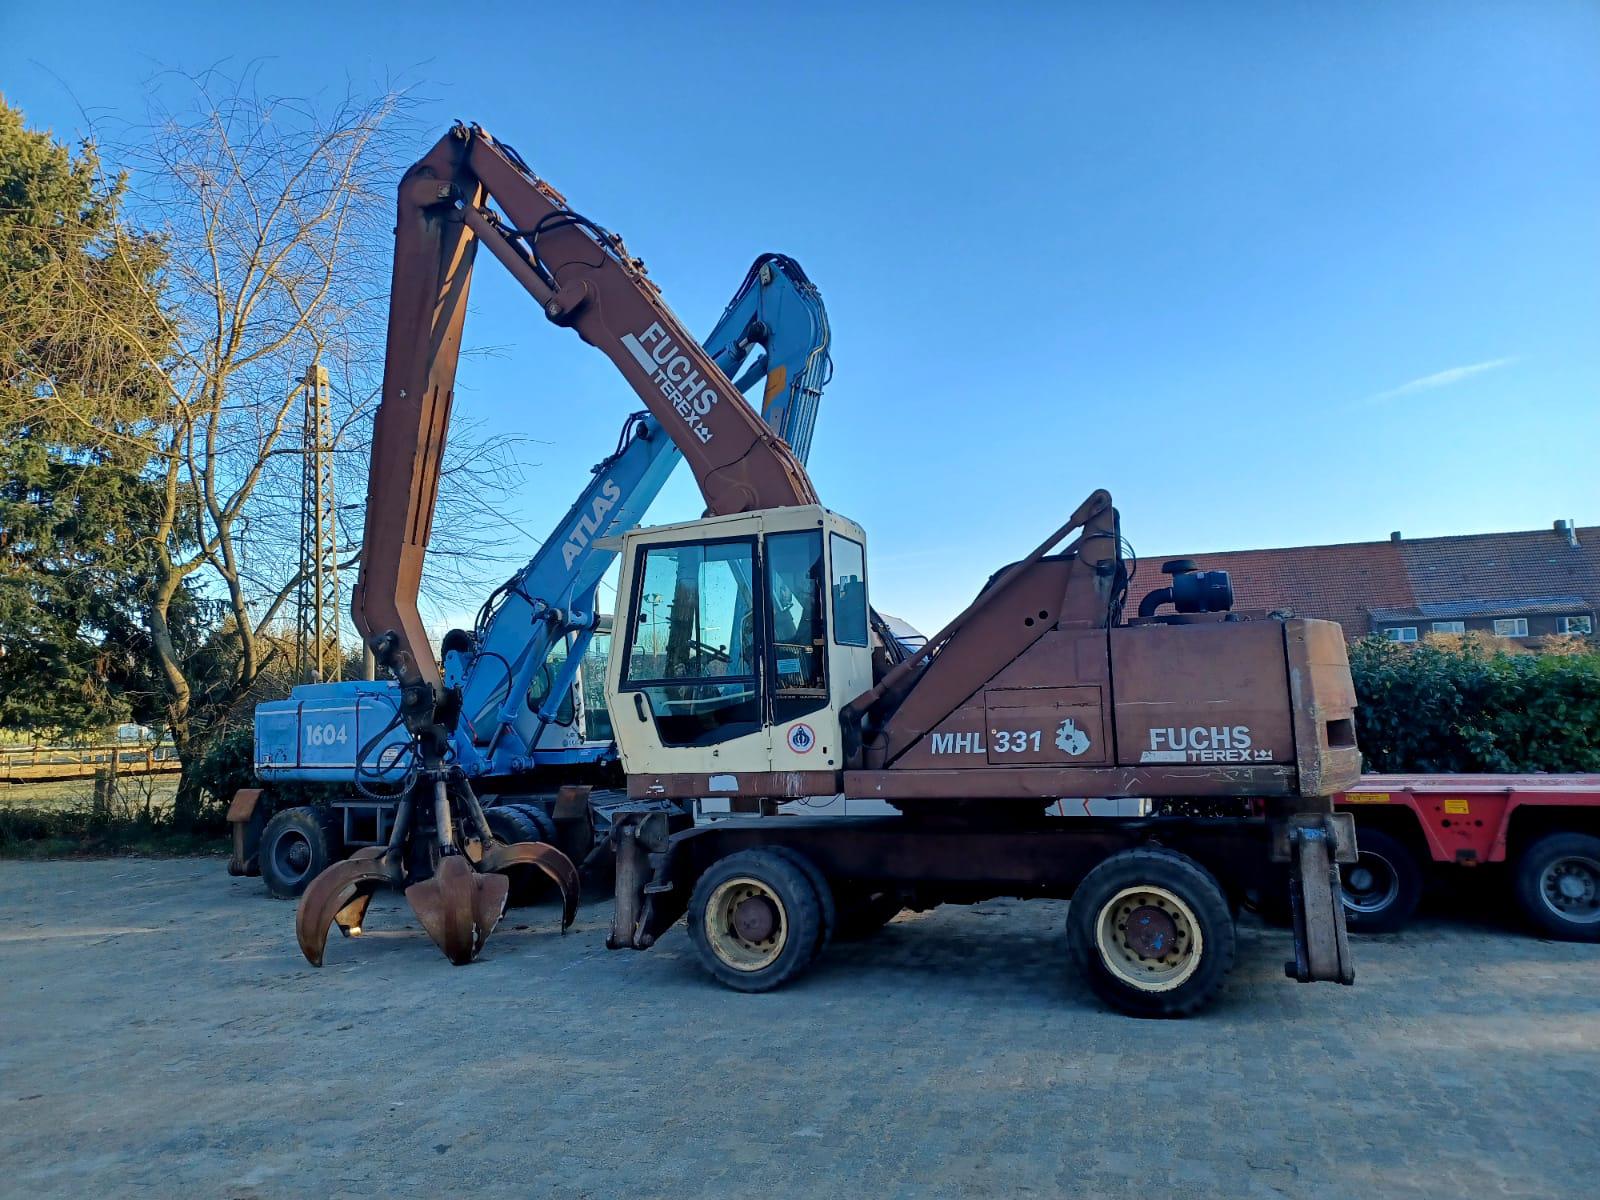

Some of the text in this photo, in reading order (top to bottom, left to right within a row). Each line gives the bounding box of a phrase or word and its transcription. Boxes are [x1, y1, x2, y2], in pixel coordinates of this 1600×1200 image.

[638, 321, 718, 415] FUCHS
[653, 368, 701, 428] TEREX
[561, 478, 621, 572] ATLAS
[306, 724, 348, 746] 1604
[931, 731, 1041, 754] MHL 331
[1149, 726, 1251, 750] FUCHS
[1188, 750, 1251, 762] TEREX
